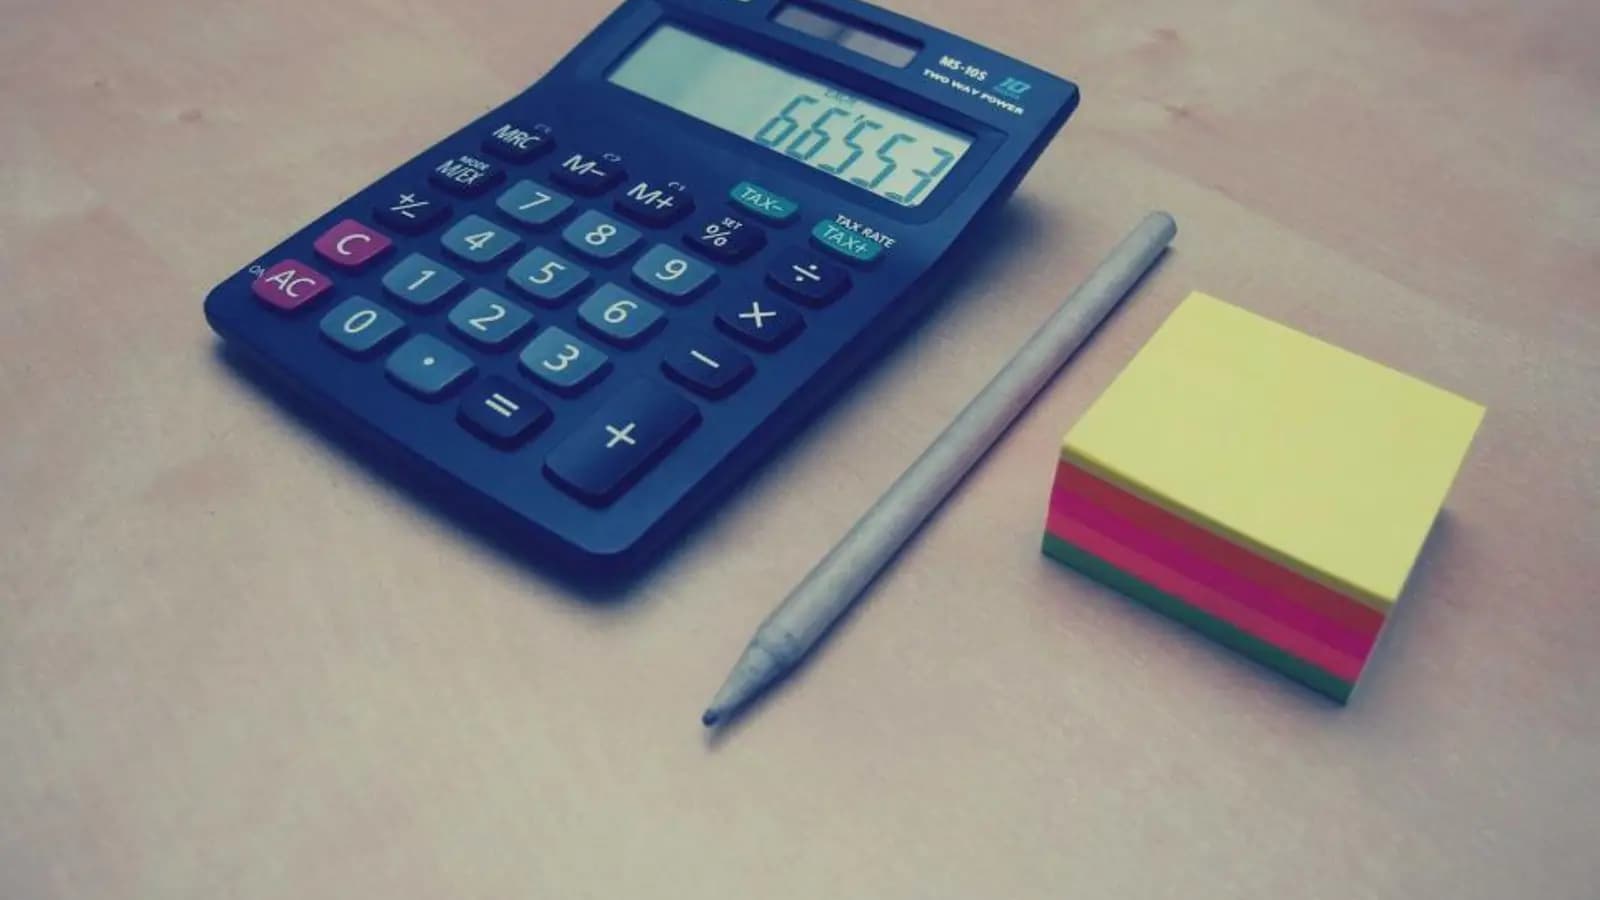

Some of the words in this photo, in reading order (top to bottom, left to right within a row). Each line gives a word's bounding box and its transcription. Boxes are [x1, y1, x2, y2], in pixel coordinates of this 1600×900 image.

[938, 55, 989, 82] MS-10S
[922, 68, 951, 84] TWO
[951, 80, 981, 96] WAY
[980, 92, 1025, 115] POWER
[492, 123, 541, 150] MRC
[459, 155, 490, 172] MODE
[518, 191, 552, 211] 7
[626, 182, 674, 210] M+
[584, 223, 618, 246] 8
[701, 223, 732, 248] %
[721, 216, 744, 231] SET
[834, 213, 864, 233] TAX
[861, 227, 897, 249] RATE
[336, 233, 372, 256] C
[463, 230, 496, 251] 4
[821, 224, 869, 255] TAX+
[406, 269, 437, 292] 1
[528, 261, 567, 285] 5
[654, 258, 689, 282] 9
[264, 269, 317, 298] AC
[343, 309, 378, 335] 0
[467, 303, 507, 332] 2
[602, 300, 639, 324] 6
[542, 344, 581, 372] 3
